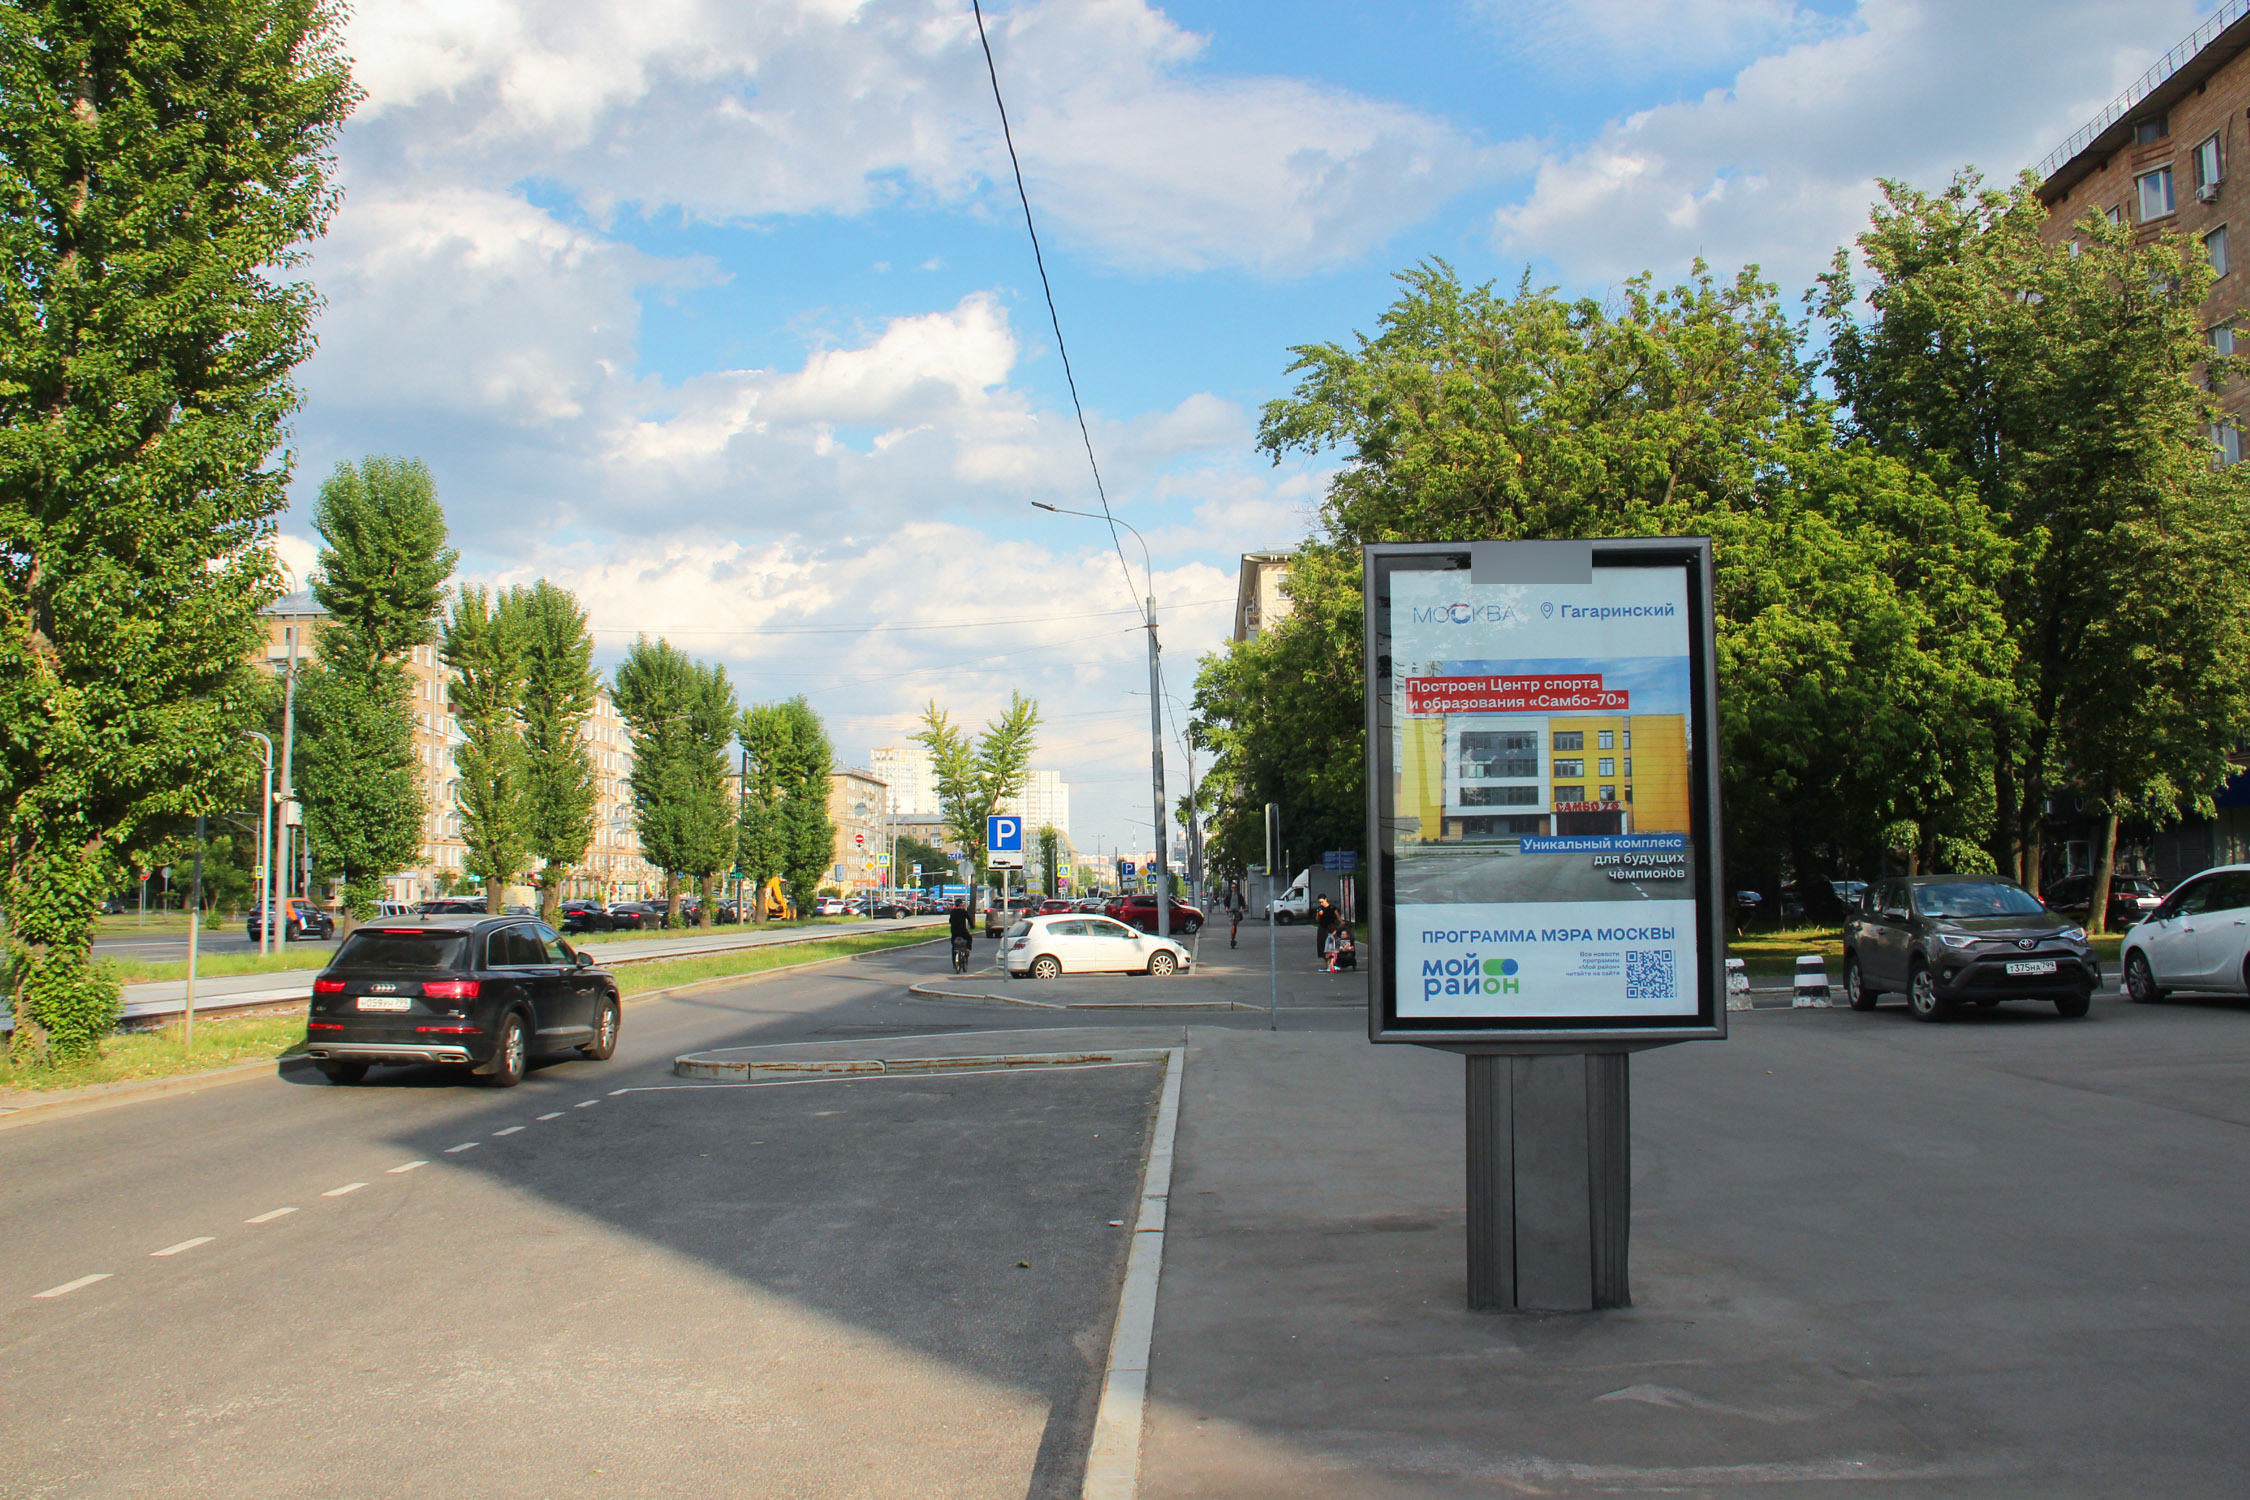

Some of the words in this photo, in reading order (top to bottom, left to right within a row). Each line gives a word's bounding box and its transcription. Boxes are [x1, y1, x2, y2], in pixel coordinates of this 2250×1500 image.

[1413, 603, 1518, 624] МОСКВА
[1561, 603, 1675, 620] Гагаринский
[1409, 679, 1486, 694] Построен
[1490, 678, 1541, 693] Центр
[1544, 678, 1599, 691] спорта
[1409, 700, 1419, 710] и
[1422, 696, 1525, 711] образования
[1529, 693, 1626, 708] «Самбо-70»
[997, 819, 1016, 848] P
[1523, 837, 1611, 850] Уникальный
[1615, 837, 1682, 849] комплекс
[1594, 854, 1620, 866] для
[1623, 852, 1685, 866] будущих
[1609, 869, 1685, 881] чемпионов
[1422, 929, 1537, 944] ПРОГРАММА
[1541, 928, 1593, 942] МЭРА
[1597, 927, 1675, 941] МОСКВЫ
